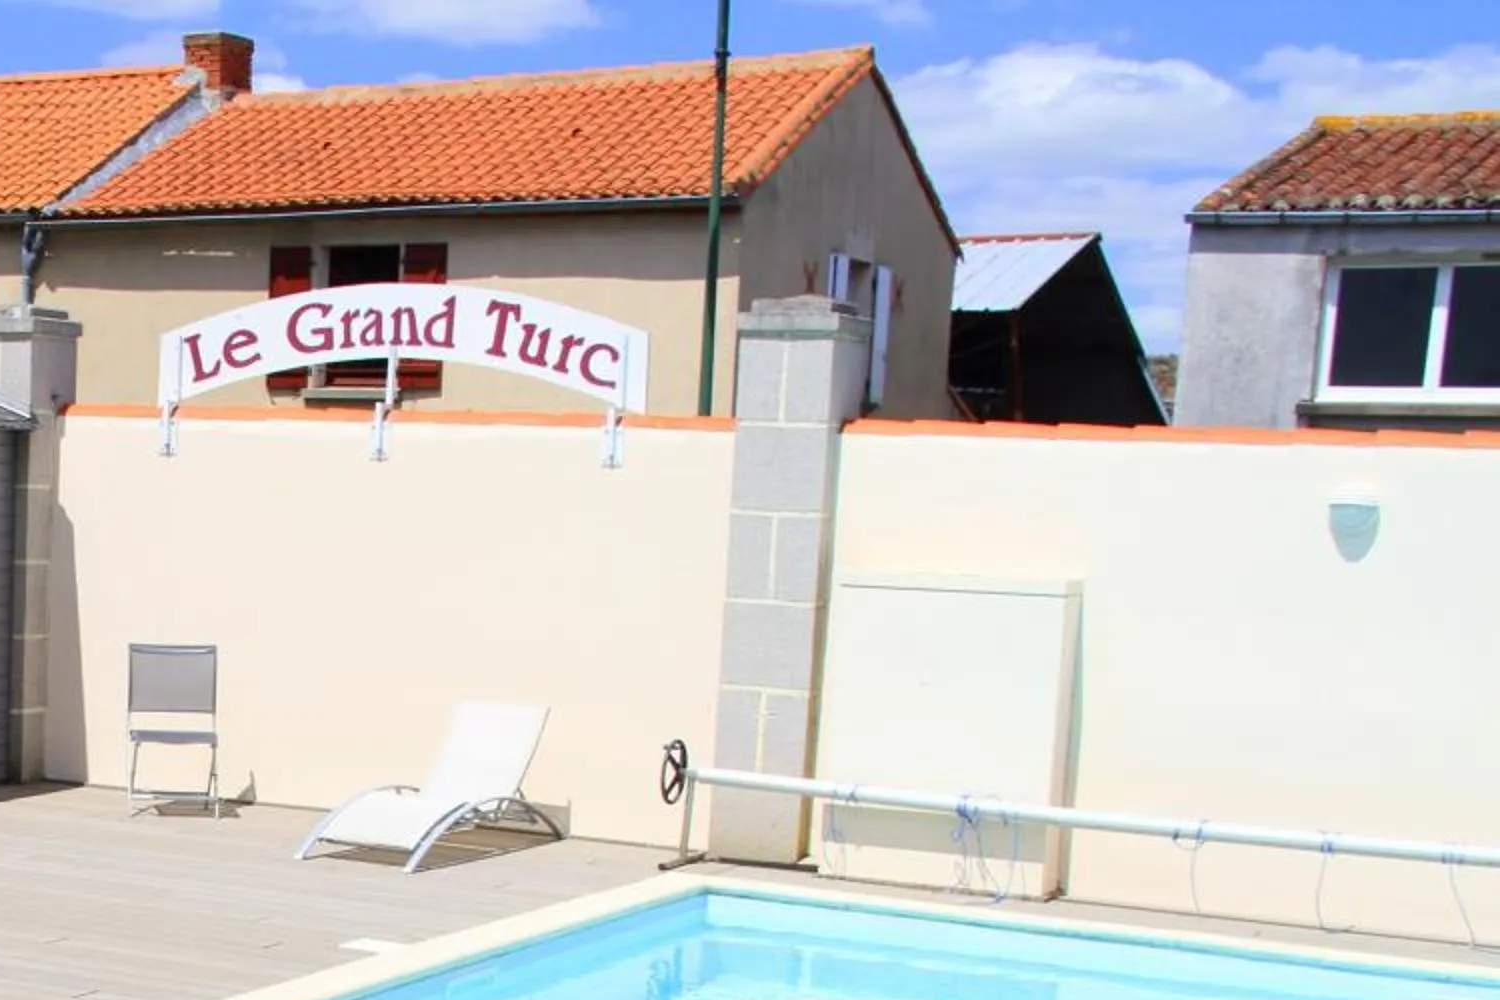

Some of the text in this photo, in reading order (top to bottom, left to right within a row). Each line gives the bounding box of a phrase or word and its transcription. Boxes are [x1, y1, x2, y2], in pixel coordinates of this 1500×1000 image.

[183, 295, 621, 389] Le Grand Turc
